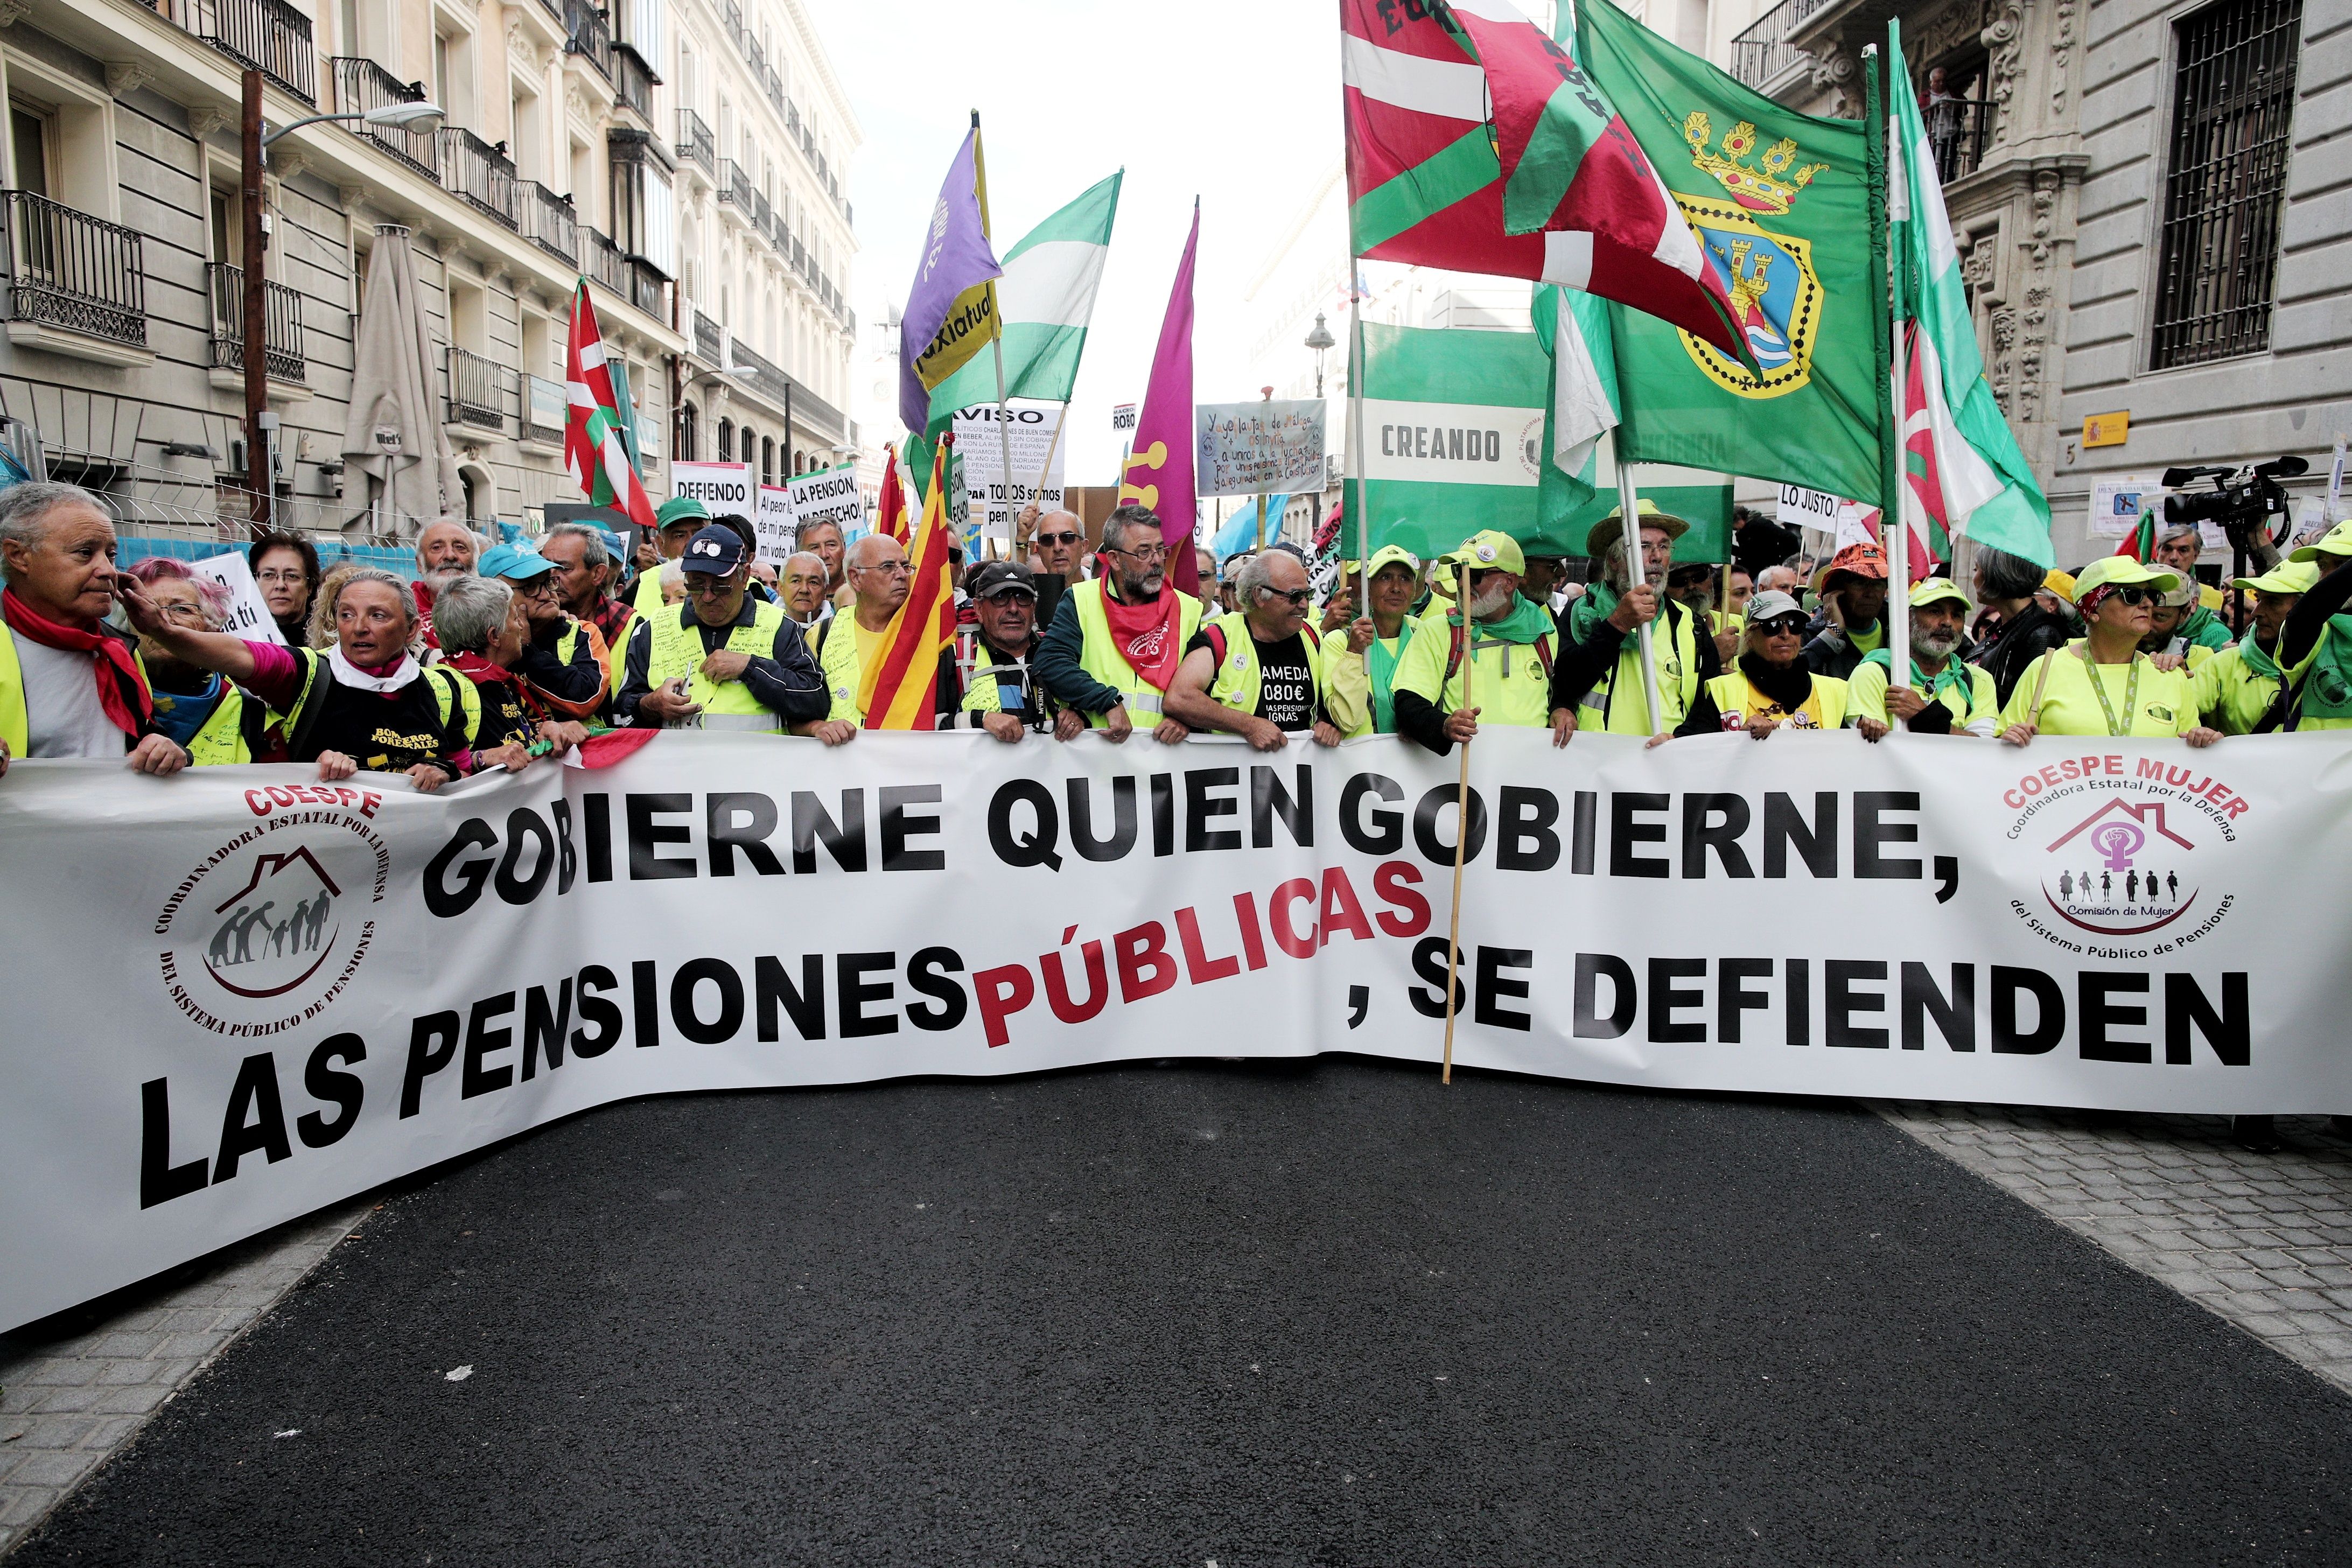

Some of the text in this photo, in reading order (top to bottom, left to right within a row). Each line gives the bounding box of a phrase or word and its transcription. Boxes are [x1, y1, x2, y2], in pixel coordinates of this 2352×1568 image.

[1114, 414, 1135, 429] ROBO
[1272, 413, 1280, 429] de
[1284, 411, 1312, 430] Málaga
[1382, 424, 1500, 462] CREANDO
[1518, 417, 1541, 451] PLATAFORMA
[1222, 451, 1228, 462] a
[1232, 448, 1256, 461] uniros
[2066, 443, 2076, 464] 5
[1216, 465, 1230, 477] por
[1264, 471, 1273, 480] en
[1519, 456, 1533, 474] DE LAS
[678, 481, 745, 502] DEFIENDO
[793, 474, 858, 505] LA PENSIÓN,
[761, 496, 770, 510] Al
[771, 500, 786, 515] peor
[1781, 484, 1835, 518] LO JUSTO.
[758, 519, 796, 538] de mi pens
[2280, 521, 2290, 541] Canon
[760, 544, 768, 557] mi
[771, 545, 787, 558] voto.
[237, 601, 257, 627] tú
[375, 728, 433, 744] BOMEROS
[2003, 755, 2249, 820] COESPE MUJER
[244, 785, 382, 820] COESPE
[2007, 780, 2236, 842] Coordinadora Estatal por la Defensa
[423, 765, 1958, 918] GOBIERNE QUIEN GOBIERNE,
[154, 811, 390, 935] COORDINADORA ESTATAL POR LA DEFENSA
[2067, 905, 2174, 918] Comisión de Mujer
[2011, 893, 2234, 959] del Sistema Público de Pensiones
[160, 920, 375, 1037] DEL SISTEMA PÚBLICO DE PENSIONES
[140, 1032, 367, 1210] LAS
[400, 946, 968, 1120] PENSIONES
[972, 860, 1432, 1048] PÚBLICAS
[1408, 937, 1532, 1032] SE
[1573, 953, 2251, 1067] DEFIENDEN
